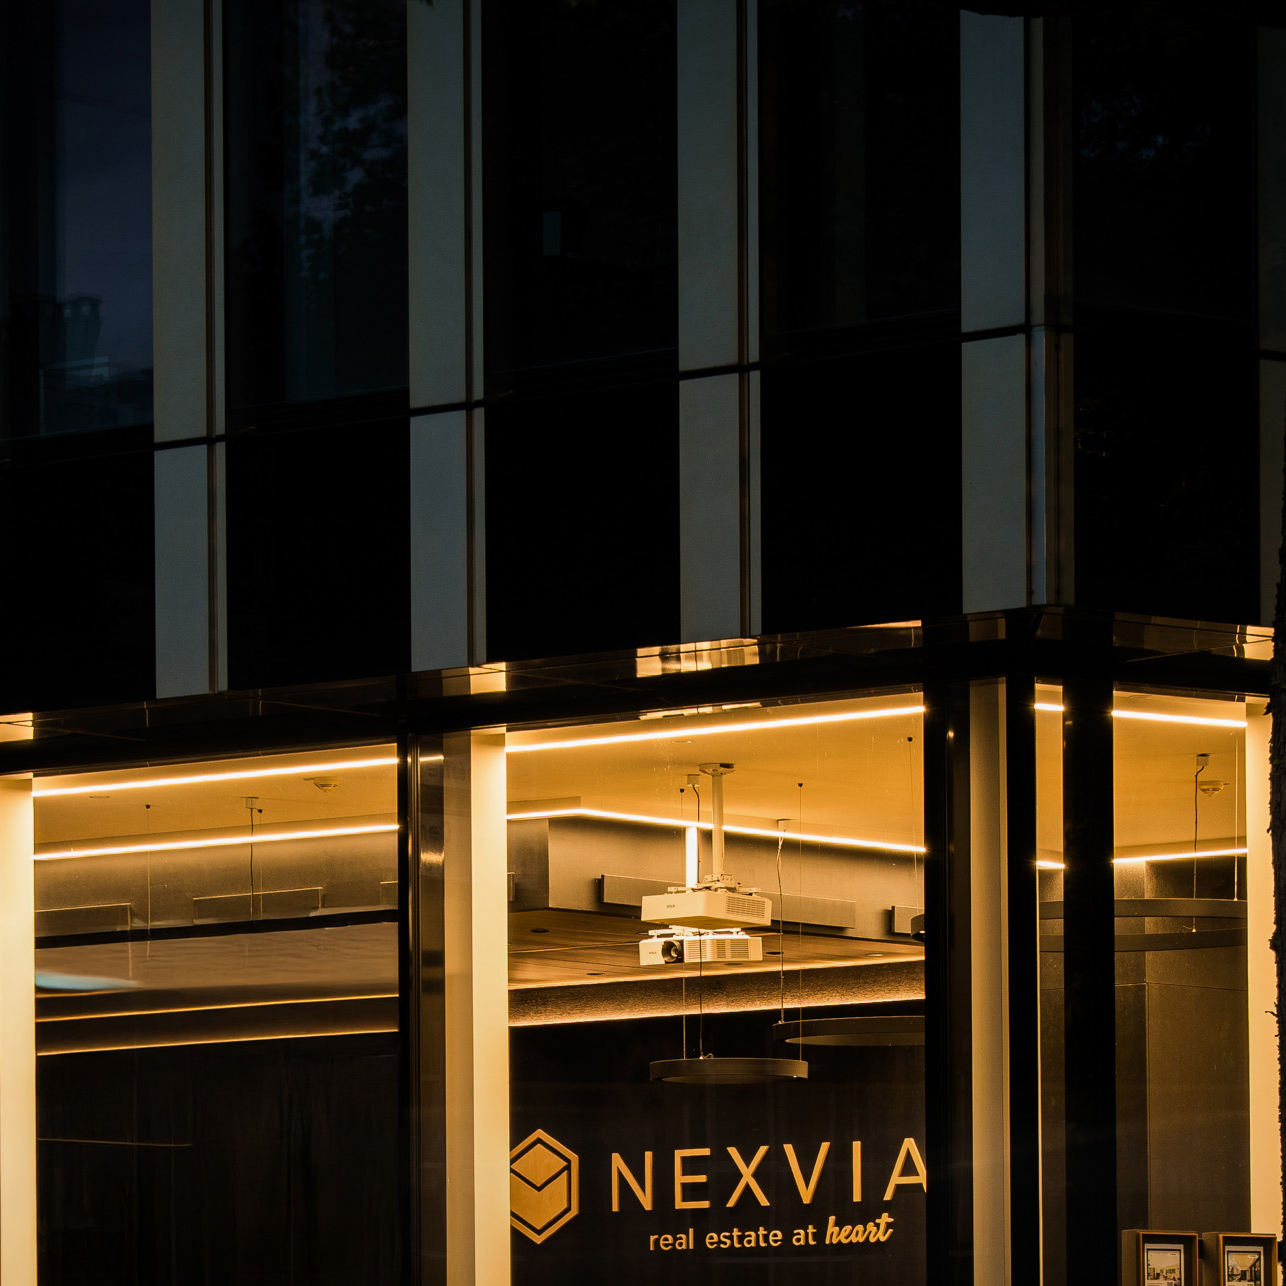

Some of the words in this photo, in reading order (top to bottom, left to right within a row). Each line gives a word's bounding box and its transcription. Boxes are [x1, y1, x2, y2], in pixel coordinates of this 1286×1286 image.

[611, 1137, 927, 1213] NEXVIA
[649, 1227, 695, 1251] real
[705, 1226, 783, 1249] estate
[792, 1224, 817, 1246] at
[825, 1212, 895, 1245] heart
